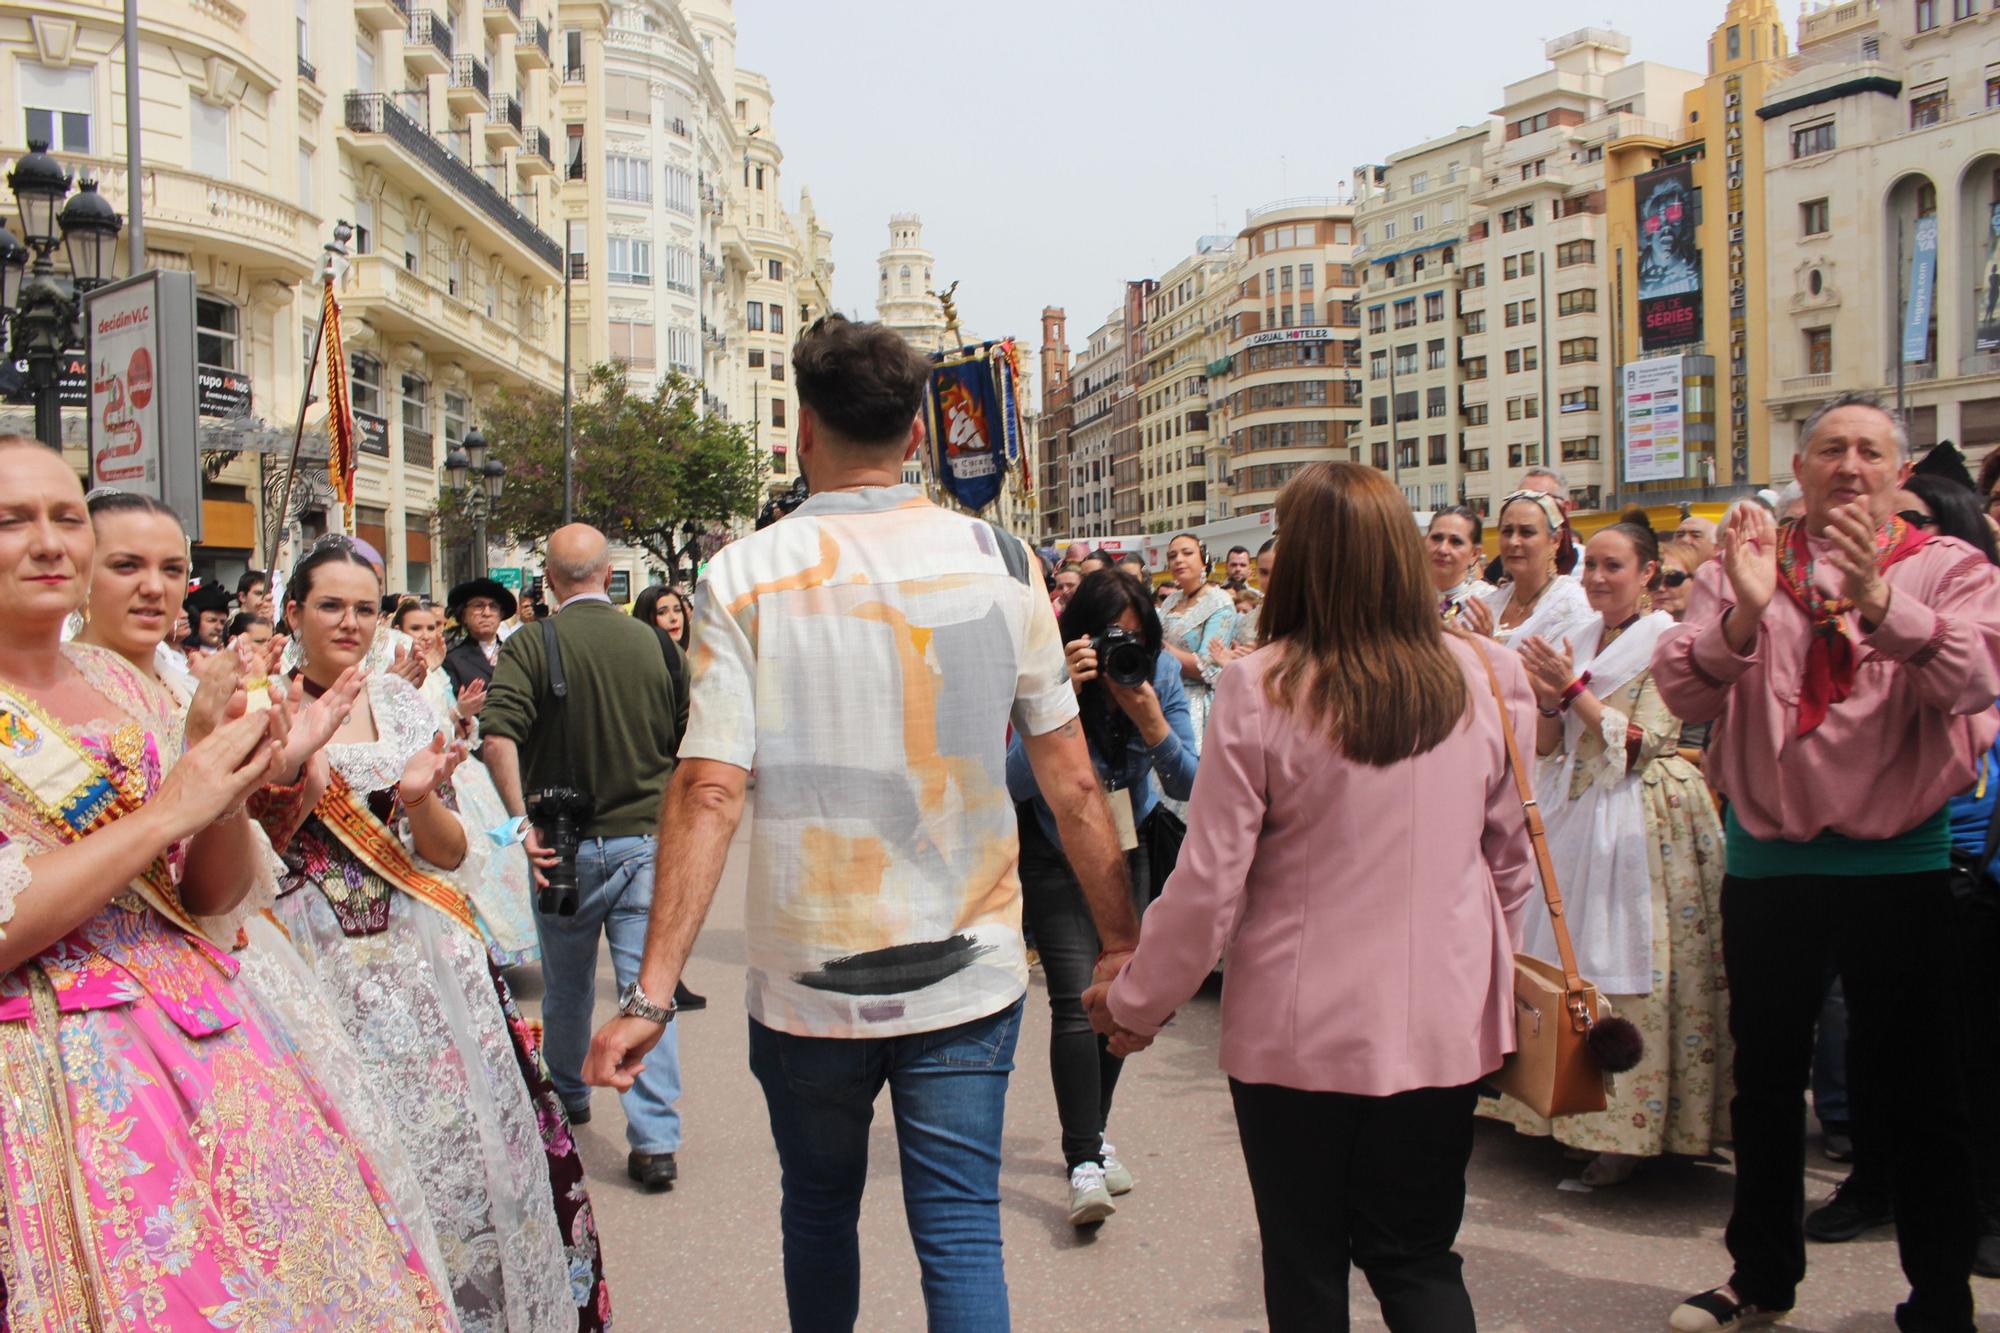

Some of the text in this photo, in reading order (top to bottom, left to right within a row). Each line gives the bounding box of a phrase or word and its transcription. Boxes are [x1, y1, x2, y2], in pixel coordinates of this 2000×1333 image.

[1724, 93, 1742, 190] RIALTO
[1728, 211, 1744, 308] TEATRE
[1254, 329, 1328, 344] CASUAL HOTELES
[1646, 306, 1694, 328] SERIES
[198, 374, 222, 389] rupo
[1730, 330, 1745, 476] FILMOTECA
